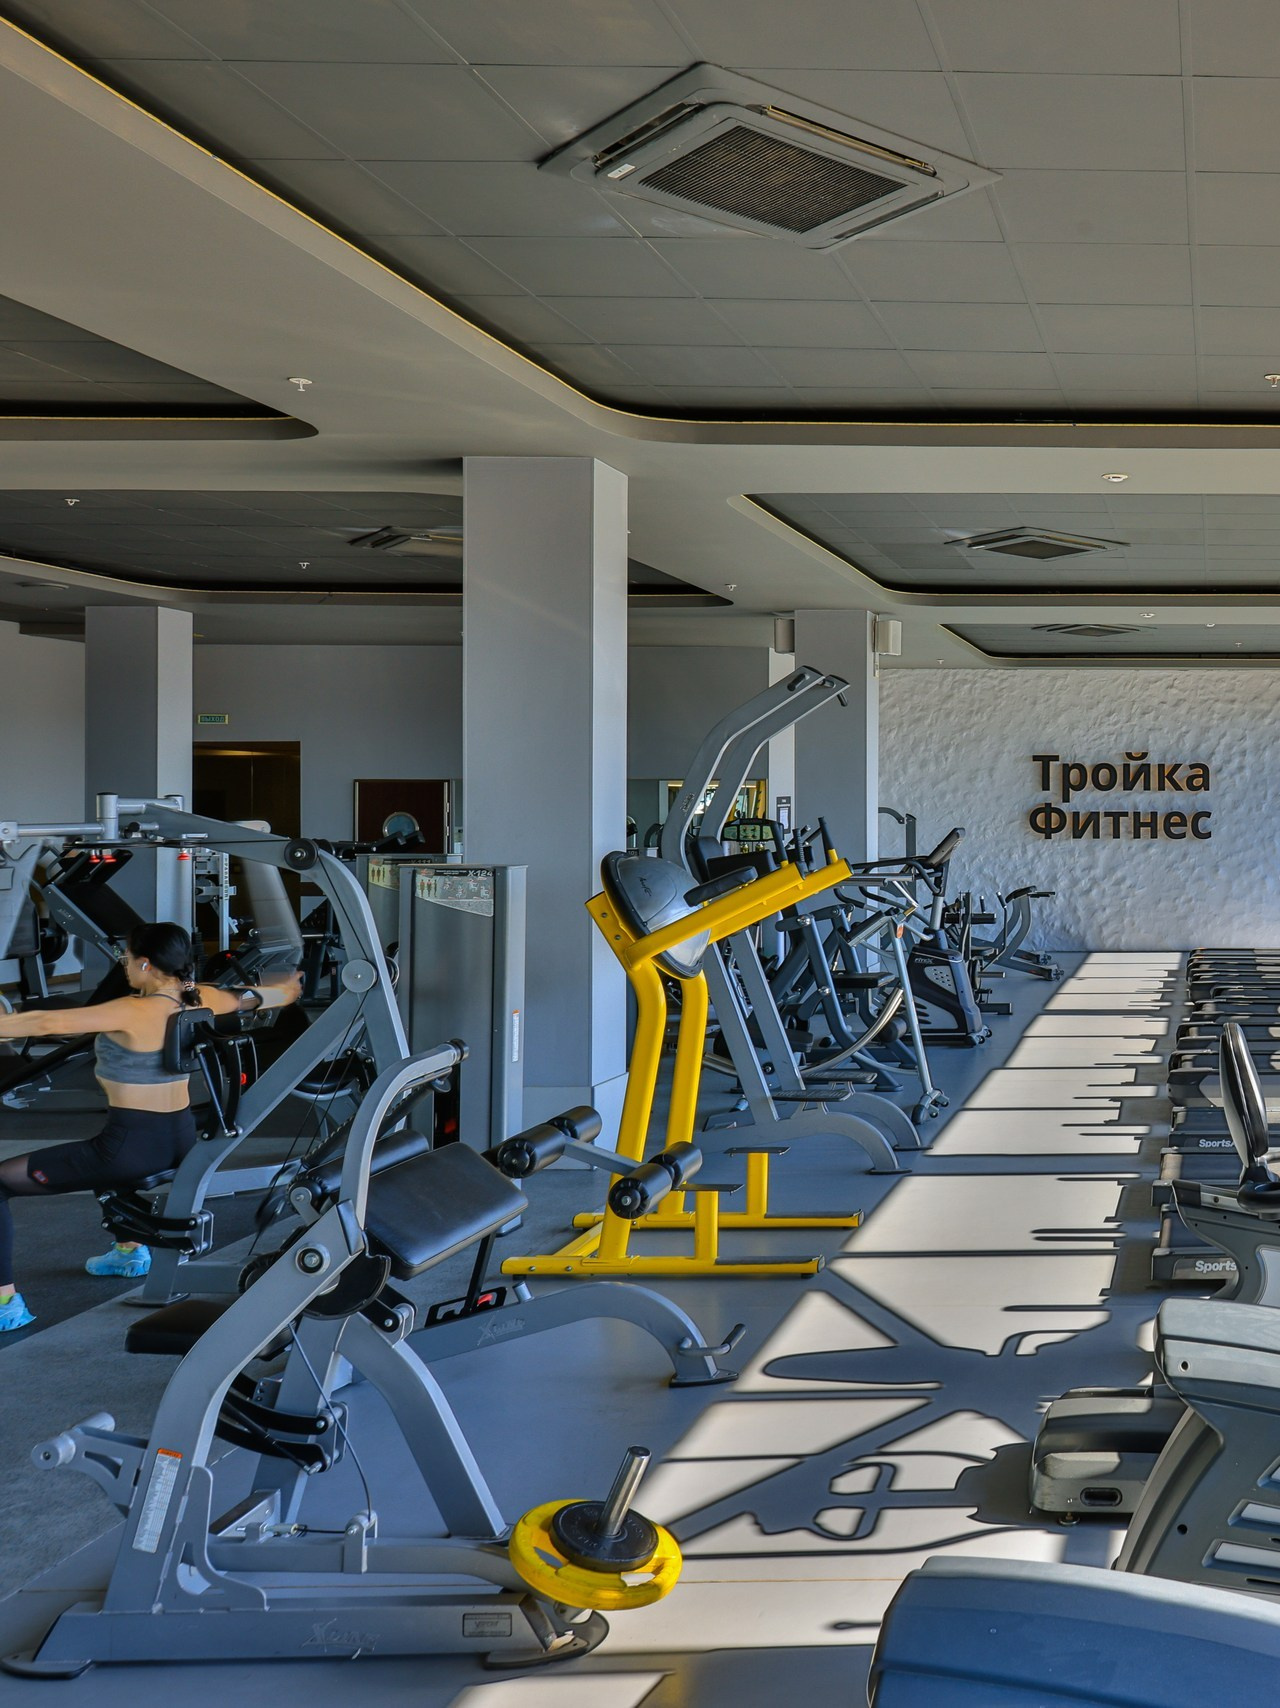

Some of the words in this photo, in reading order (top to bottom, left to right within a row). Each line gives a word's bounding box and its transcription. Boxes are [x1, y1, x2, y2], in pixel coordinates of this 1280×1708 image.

[1032, 752, 1210, 803] Тройка
[1029, 802, 1212, 840] Фитнес
[467, 869, 493, 877] X-124
